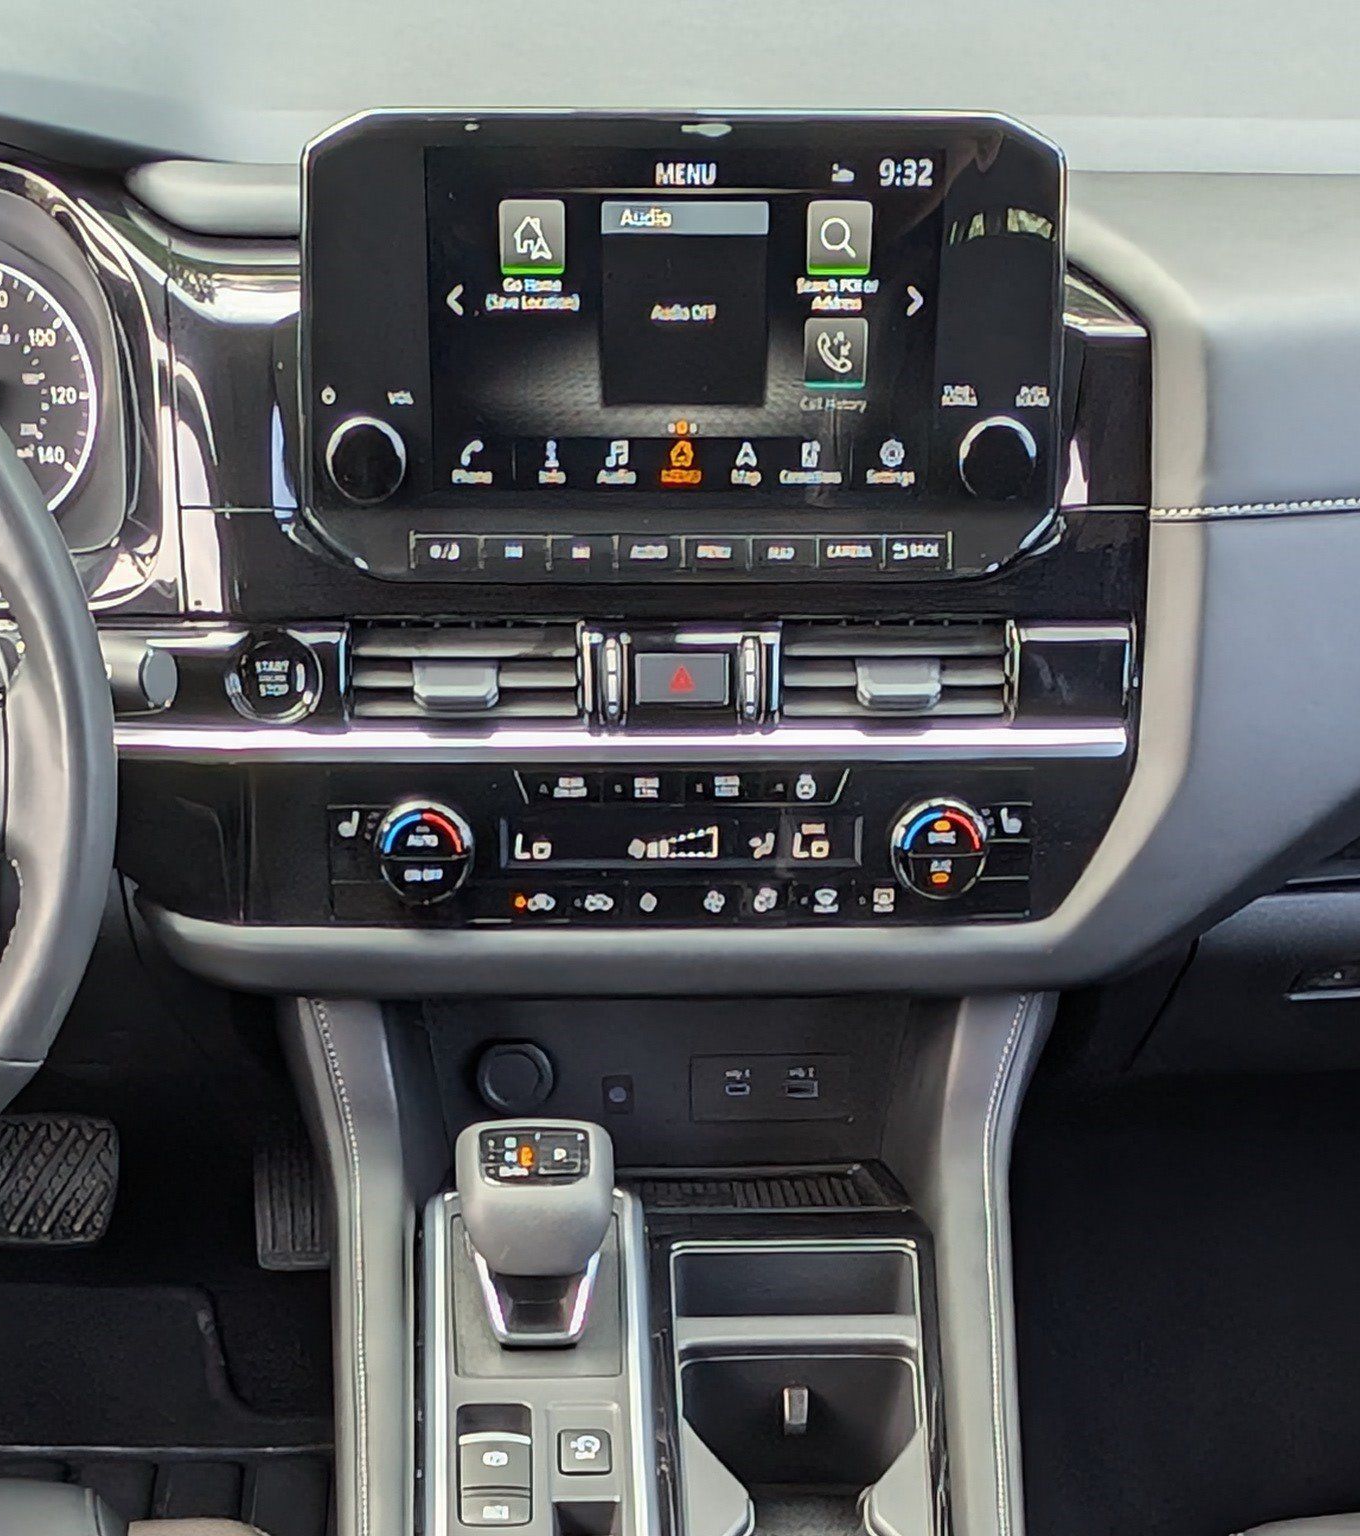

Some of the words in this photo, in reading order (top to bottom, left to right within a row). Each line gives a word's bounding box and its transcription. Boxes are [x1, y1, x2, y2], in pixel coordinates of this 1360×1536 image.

[655, 161, 717, 186] MENU
[879, 157, 934, 187] 9:32
[620, 208, 673, 228] Audio
[28, 329, 56, 347] 100
[50, 392, 77, 411] 120
[37, 446, 65, 464] 140
